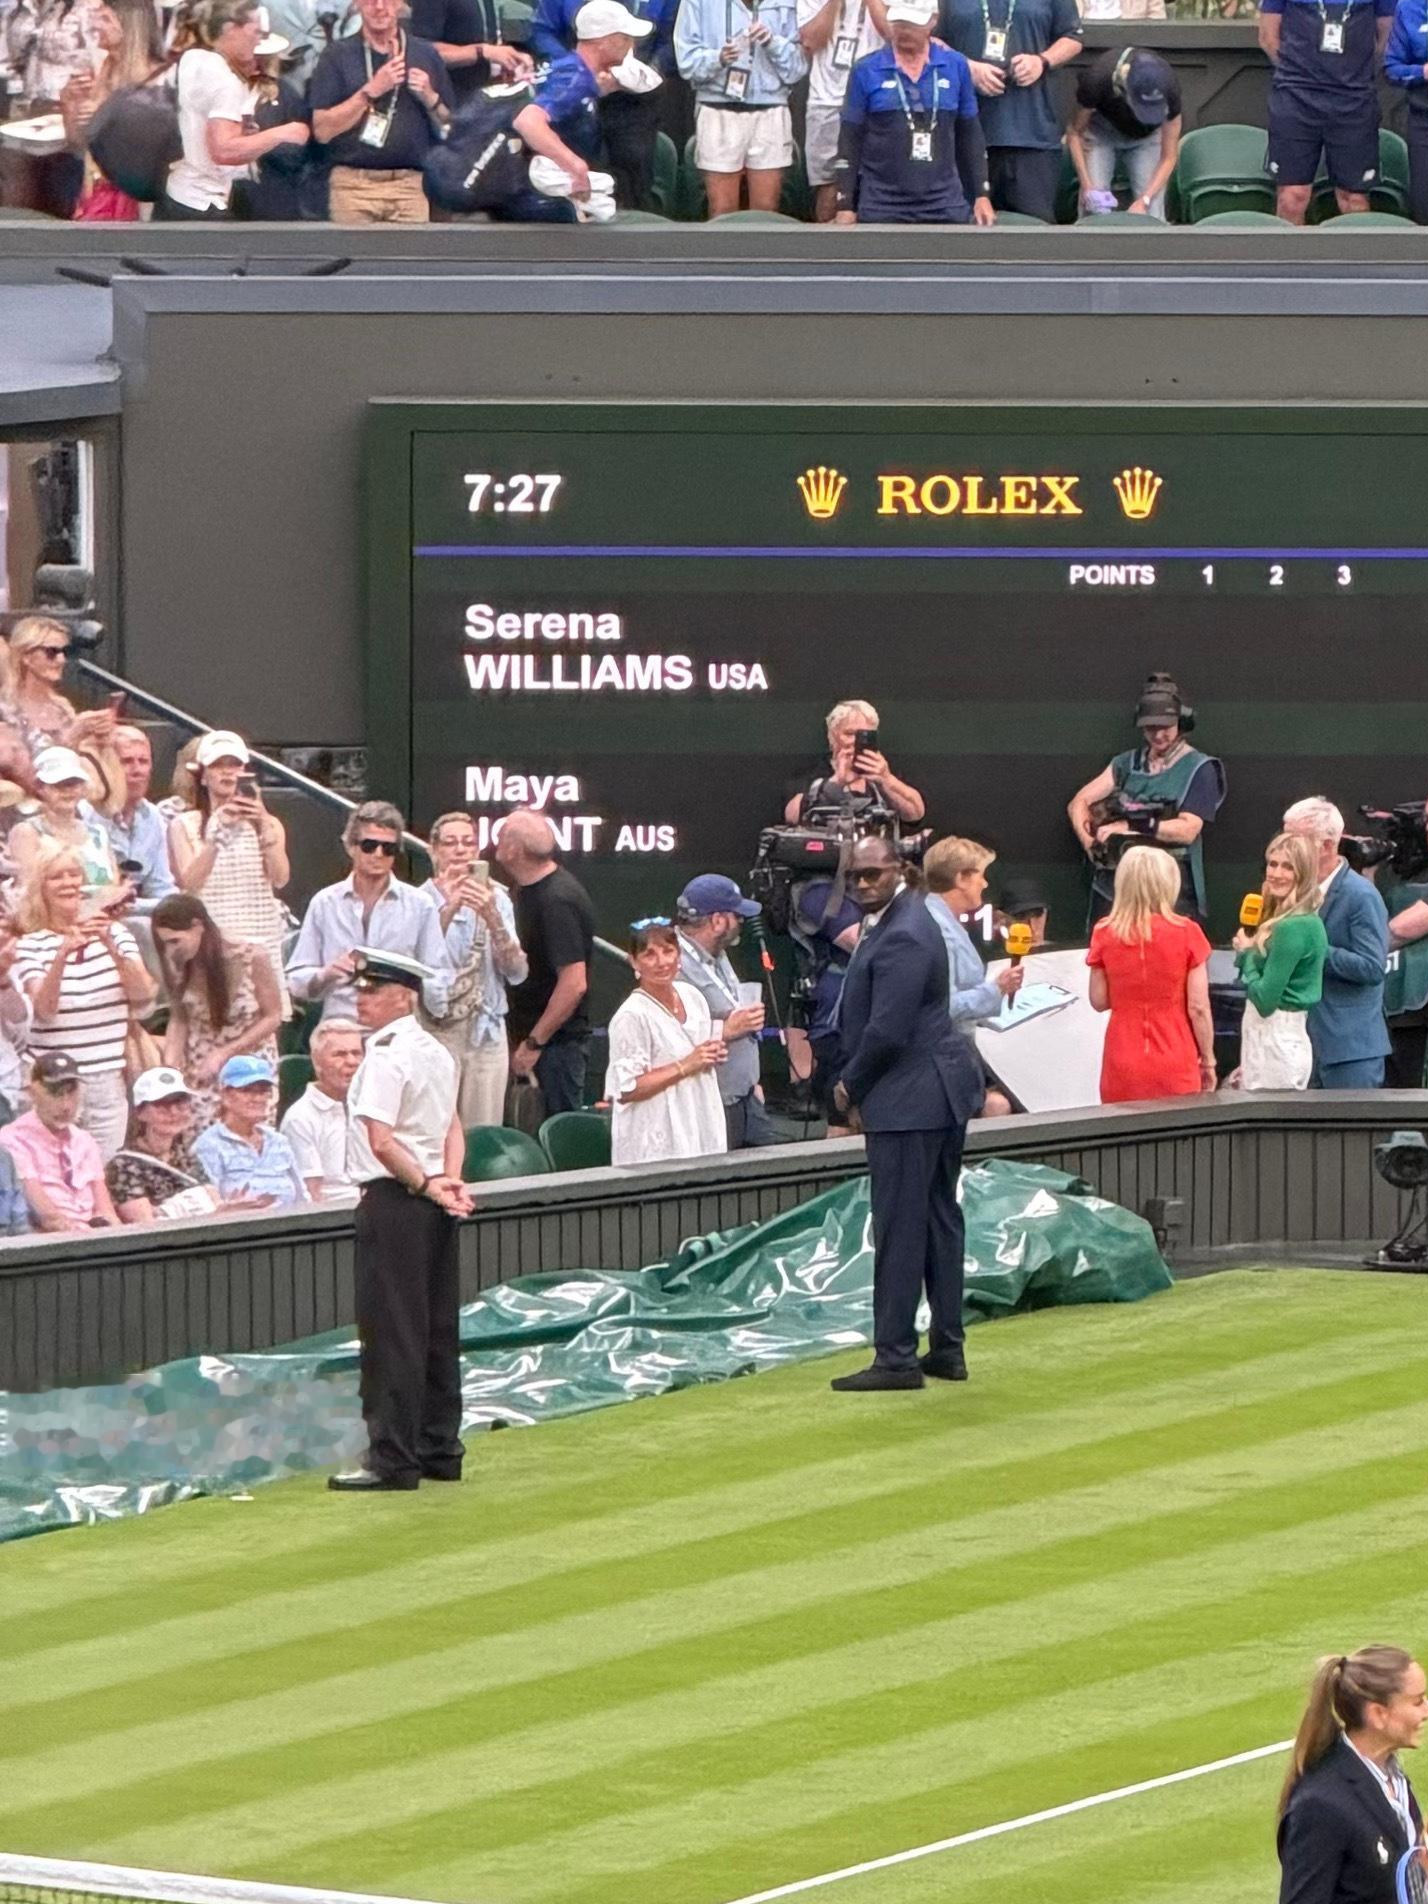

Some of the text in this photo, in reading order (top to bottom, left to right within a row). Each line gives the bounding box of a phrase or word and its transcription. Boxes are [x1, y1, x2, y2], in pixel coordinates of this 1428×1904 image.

[463, 473, 562, 513] 7:27
[876, 474, 1084, 517] ROLEX
[1068, 564, 1352, 586] POINTS 1 2 3
[464, 603, 622, 641] Serena
[463, 653, 769, 691] WILLIAMS USA
[465, 765, 580, 810] Maya
[477, 815, 677, 853] JNT AUS
